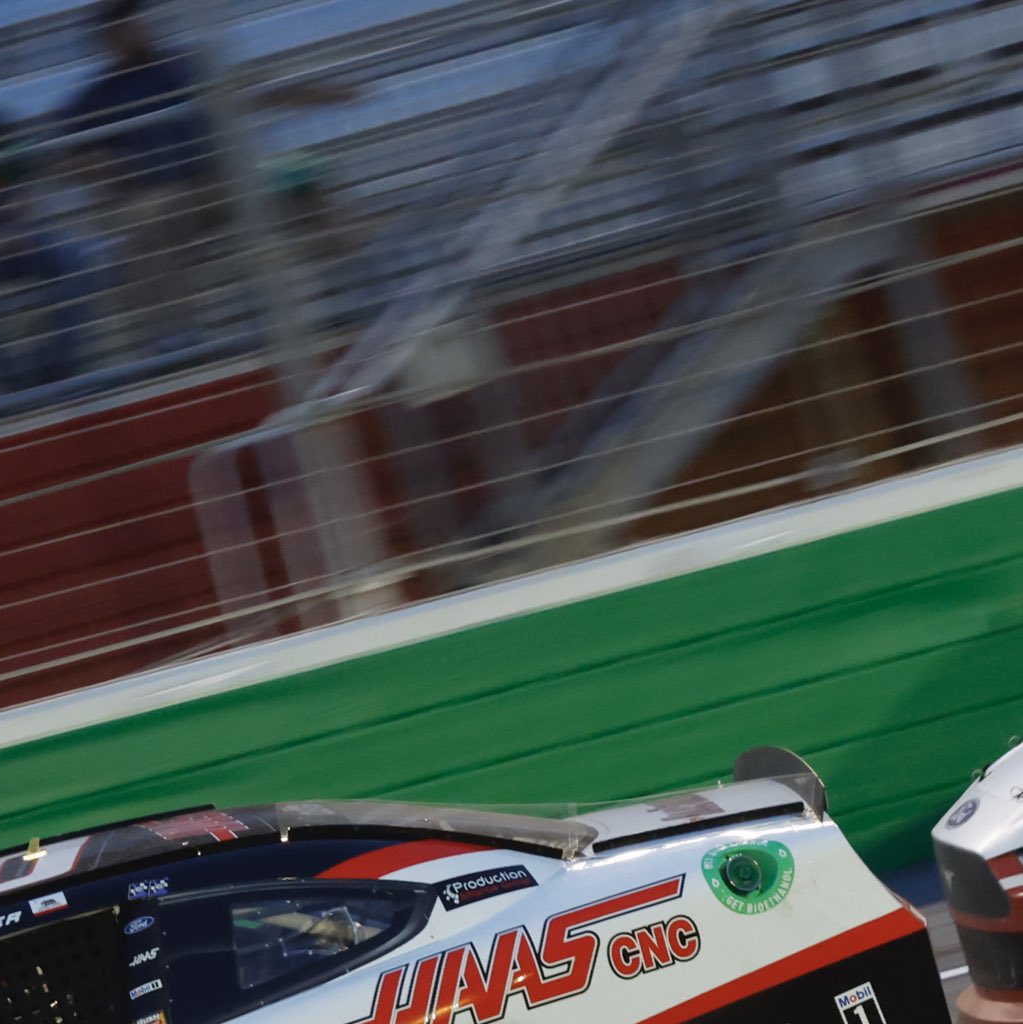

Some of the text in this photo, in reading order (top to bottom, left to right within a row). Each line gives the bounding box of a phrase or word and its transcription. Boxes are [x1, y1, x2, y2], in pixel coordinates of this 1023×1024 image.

[453, 870, 527, 893] Production
[607, 913, 701, 980] CNC
[837, 985, 872, 1009] Mobil
